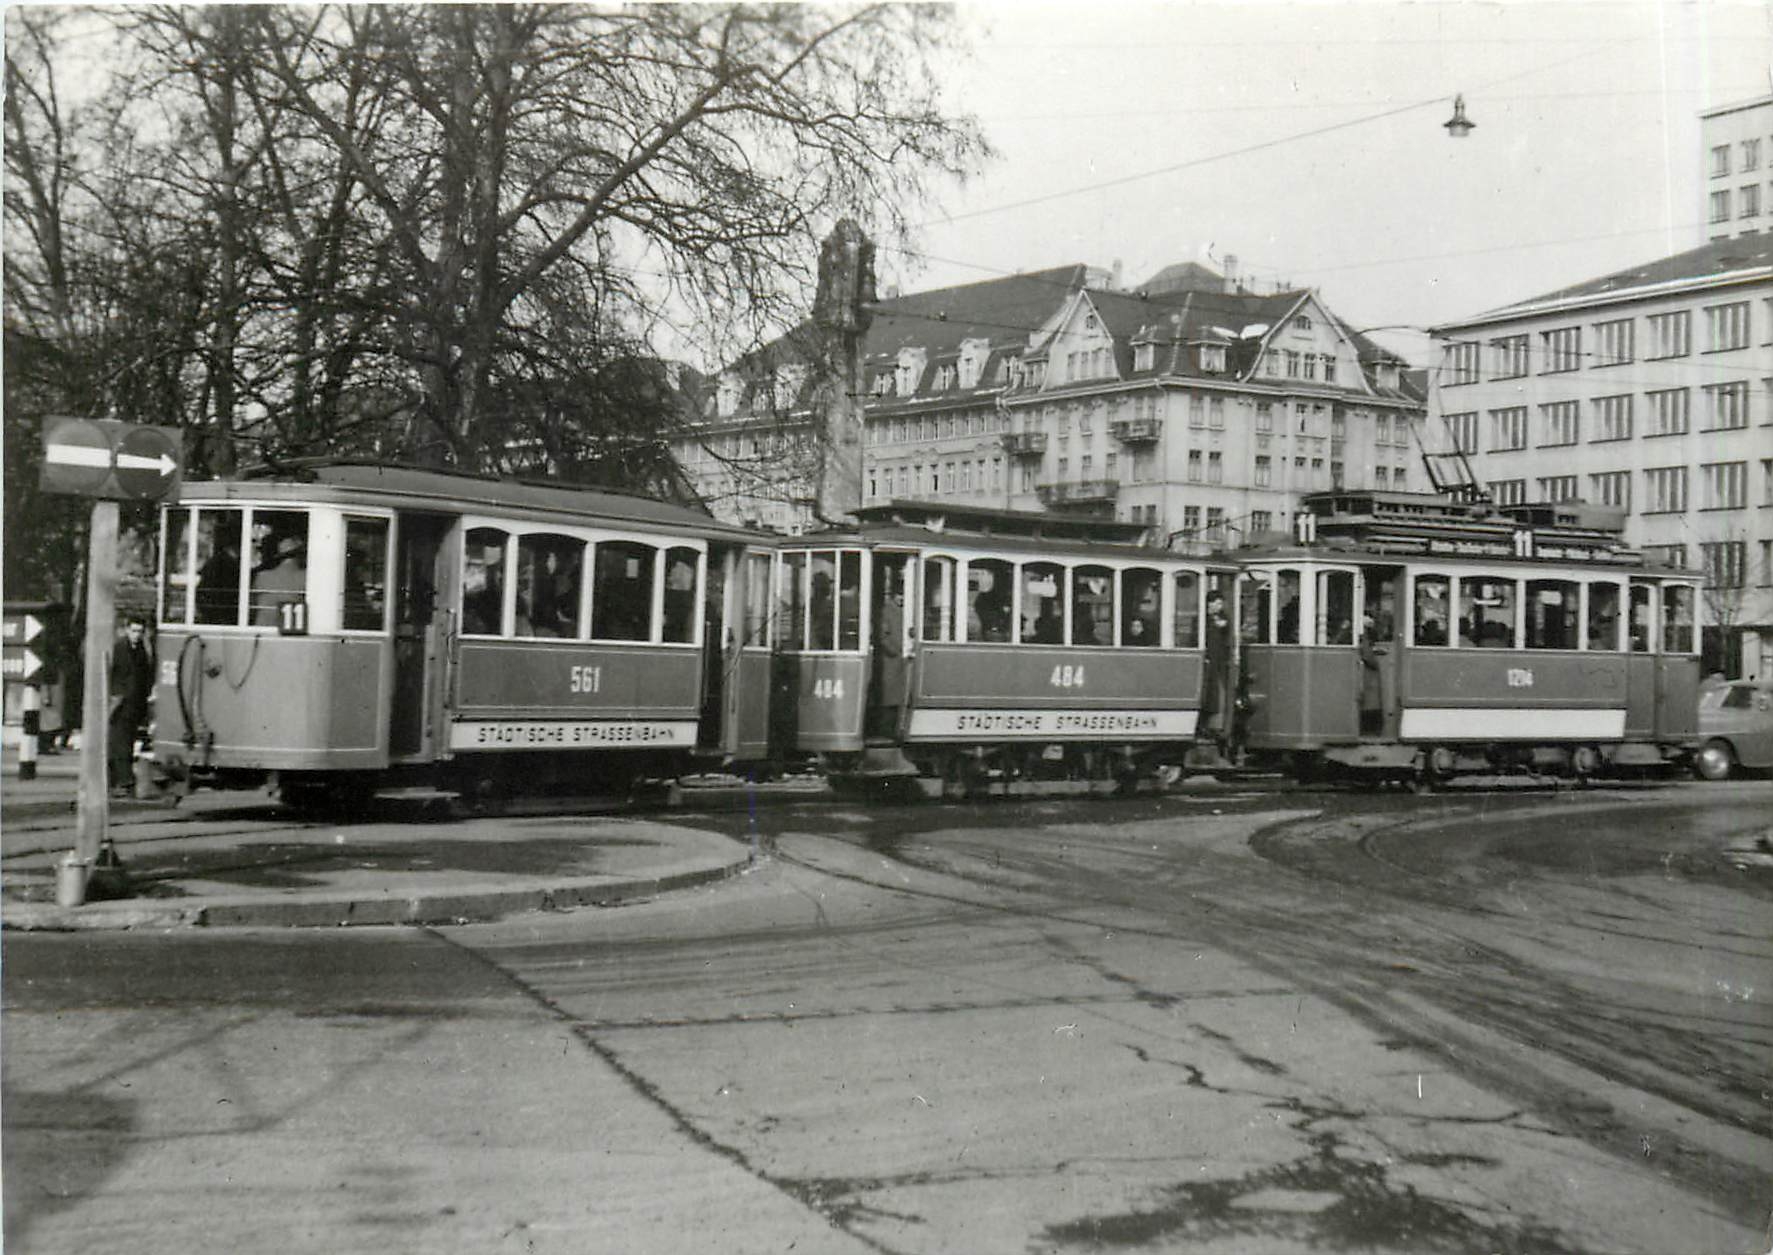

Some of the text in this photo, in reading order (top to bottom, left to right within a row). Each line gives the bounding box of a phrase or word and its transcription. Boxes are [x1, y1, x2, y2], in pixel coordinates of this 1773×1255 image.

[1297, 513, 1316, 542] 11
[1513, 530, 1532, 557] 11
[280, 604, 303, 630] 11
[570, 666, 601, 693] 561
[814, 679, 845, 700] 484
[1050, 664, 1085, 689] 484
[1056, 715, 1157, 730] STRASSENBAHN
